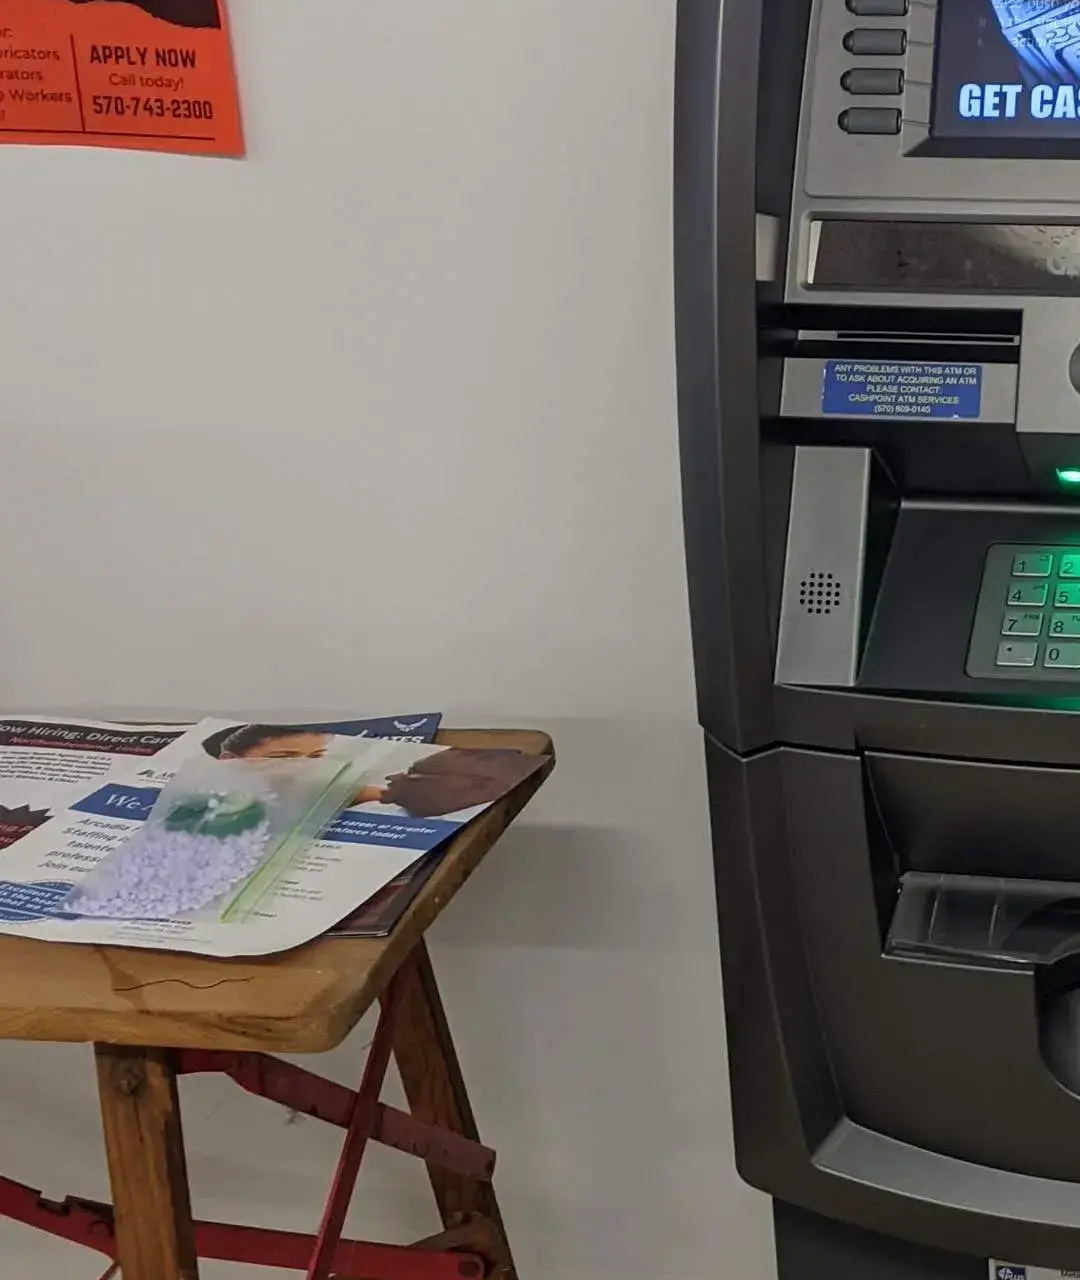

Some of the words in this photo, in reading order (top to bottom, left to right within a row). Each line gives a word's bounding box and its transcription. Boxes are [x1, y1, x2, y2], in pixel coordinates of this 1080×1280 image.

[90, 45, 147, 66] APPLY
[155, 49, 196, 68] NOW
[109, 73, 135, 86] Call
[140, 75, 184, 91] today!
[11, 90, 72, 103] Workers
[958, 83, 1021, 118] GET
[92, 95, 213, 119] 570-743-2300
[867, 385, 898, 393] PLEASE
[1020, 561, 1025, 572] 1
[1063, 562, 1073, 572] 2
[1012, 591, 1023, 601] 4
[1058, 592, 1068, 603] 5
[1008, 619, 1017, 631] 7
[1053, 621, 1063, 633] 8
[1049, 648, 1059, 660] 0
[30, 726, 84, 740] Hiring:
[87, 732, 138, 744] Direct
[107, 794, 141, 810] We
